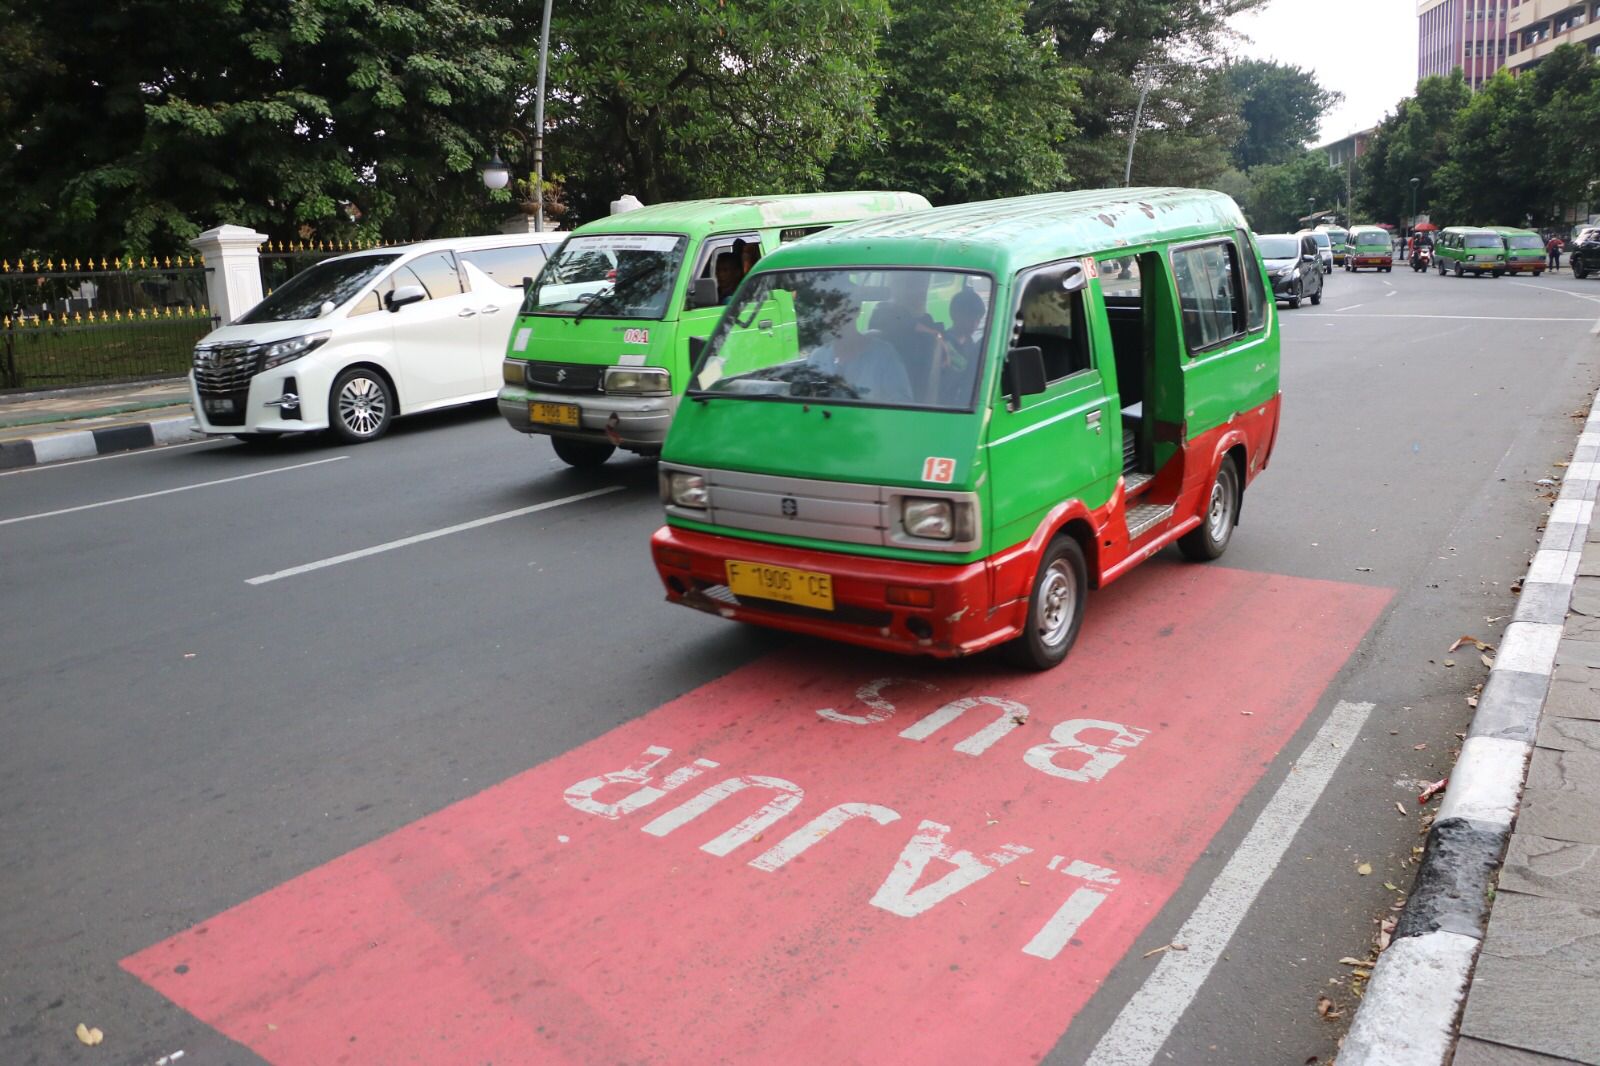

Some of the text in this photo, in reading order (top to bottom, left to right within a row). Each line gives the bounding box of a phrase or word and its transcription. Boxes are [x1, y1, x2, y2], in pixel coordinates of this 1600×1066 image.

[1082, 257, 1097, 278] 13
[924, 458, 954, 482] 13
[730, 563, 740, 582] F
[754, 567, 792, 591] 1906
[808, 575, 829, 598] CE
[815, 677, 1151, 782] BUS
[563, 745, 1121, 960] LAJUR
